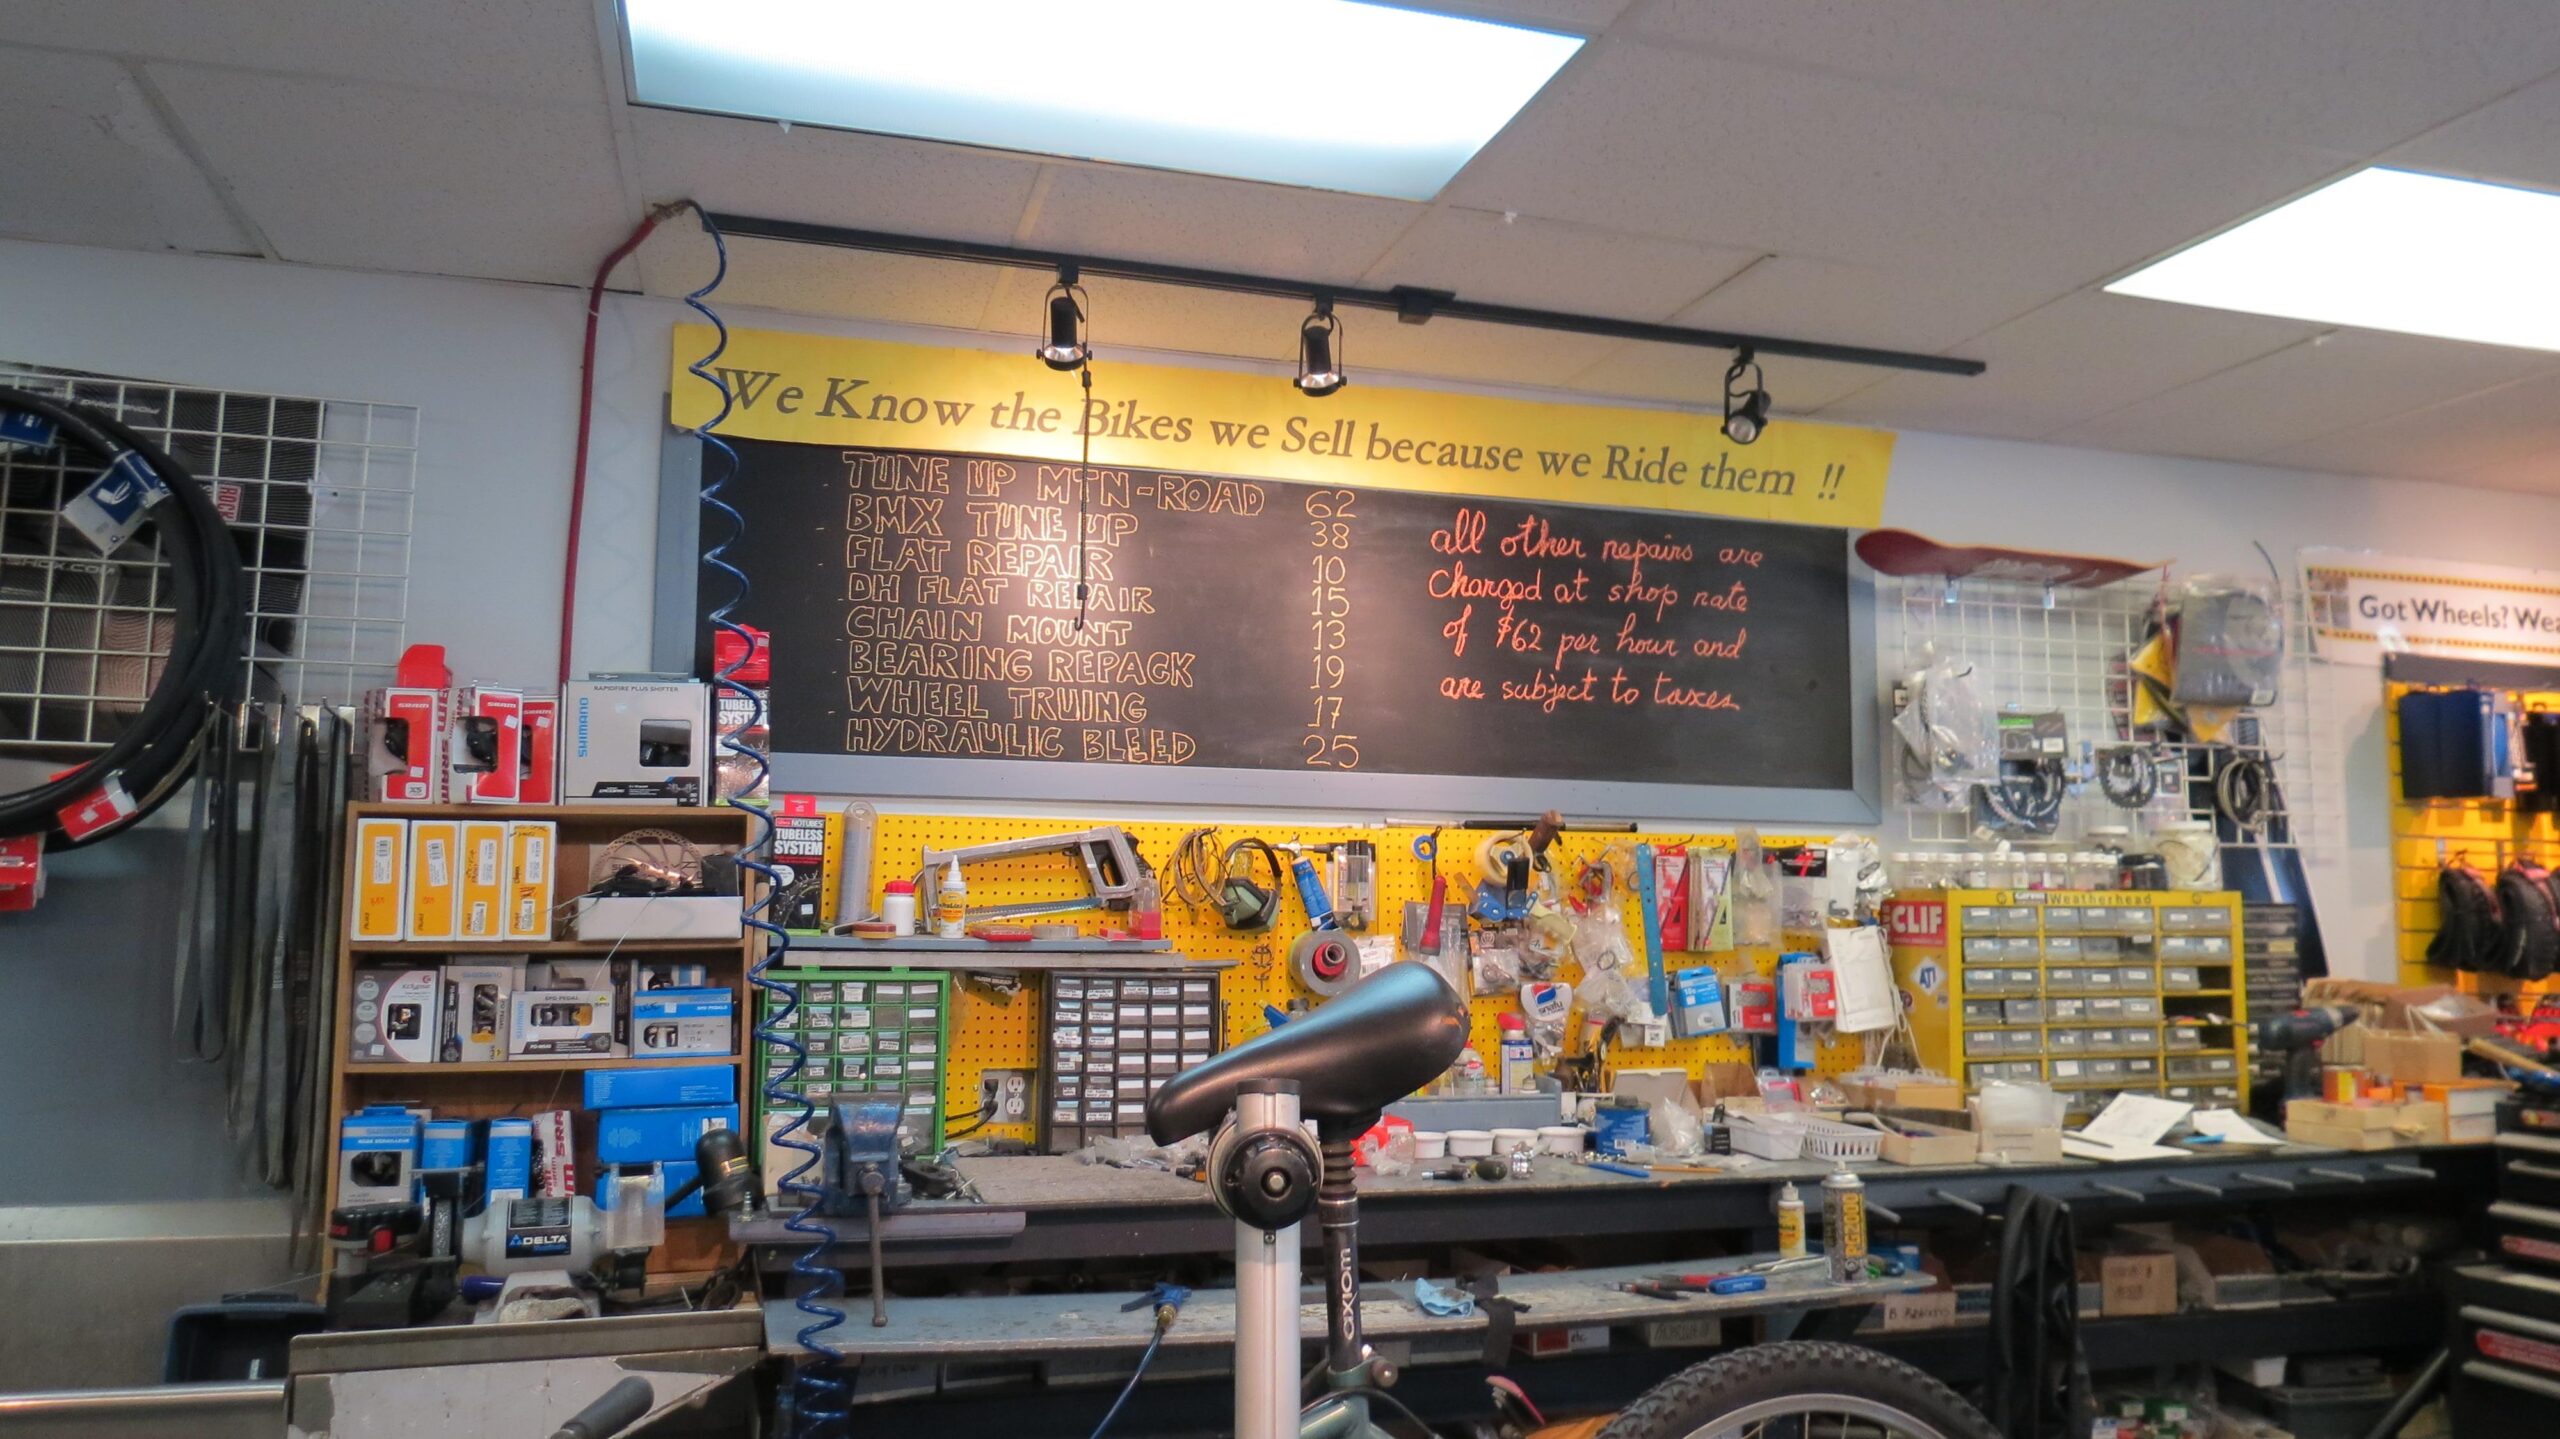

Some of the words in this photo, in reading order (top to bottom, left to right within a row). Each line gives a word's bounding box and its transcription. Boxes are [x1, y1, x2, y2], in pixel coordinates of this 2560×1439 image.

[714, 366, 804, 414] We
[815, 377, 975, 427] Know
[990, 391, 1062, 433] the
[1072, 398, 1193, 443] Bikes
[1209, 420, 1270, 449] we
[1281, 416, 1356, 458] Sell
[1365, 421, 1523, 473] because
[1536, 450, 1592, 477] we
[1602, 444, 1688, 486] Ride
[1700, 451, 1796, 497] them
[1817, 463, 1846, 500] !!
[843, 451, 949, 494] TUNE
[967, 460, 1016, 497] UP
[1306, 490, 1357, 518] 62
[846, 493, 944, 536] BMX
[966, 502, 1067, 541] TUNE
[1078, 512, 1139, 547] UP
[1310, 521, 1350, 549] 38
[1430, 508, 1486, 554] all
[1500, 514, 1586, 559] other
[1602, 534, 1694, 571] repairs
[1719, 547, 1764, 568] are
[847, 534, 951, 573] FLAT
[967, 538, 1114, 581] REPAIR
[1312, 554, 1346, 585] 10
[849, 572, 900, 603] DH
[918, 575, 1008, 606] FLAT
[1027, 578, 1156, 613] REPAIR
[1311, 586, 1350, 618] 15
[1554, 567, 1590, 602] at
[1608, 569, 1679, 622] shop
[2359, 595, 2408, 621] Got
[2411, 598, 2509, 629] Wheels?
[847, 606, 983, 642] CHAIN
[1006, 615, 1133, 647] MOUNT
[1312, 619, 1346, 651] 13
[1443, 604, 1472, 657] of
[1496, 605, 1542, 652] $62
[1558, 632, 1600, 671] per
[1617, 612, 1679, 657] hour
[1693, 628, 1747, 659] and
[849, 640, 1033, 682] BEARING
[1048, 649, 1196, 688] REPACK
[1310, 654, 1345, 689] 19
[719, 699, 768, 711] TUBELES
[847, 676, 989, 719] WHEEL
[1008, 686, 1148, 724] TRUING
[1307, 695, 1344, 729] 17
[1440, 676, 1486, 700] are
[1501, 668, 1598, 713] subject
[1611, 667, 1640, 705] to
[578, 697, 589, 757] SHIMANO
[846, 717, 1064, 757] HYDRAULIC
[1082, 727, 1197, 765] BLEED
[1303, 734, 1359, 769] 25
[775, 828, 824, 841] TUBELESS
[791, 819, 823, 828] NOTUBES
[774, 842, 823, 856] SYSTEM
[1892, 904, 1942, 935] CLIF
[2050, 894, 2152, 906] Weatherhead
[523, 1234, 567, 1244] DELTA
[1842, 1192, 1862, 1257] PG2000
